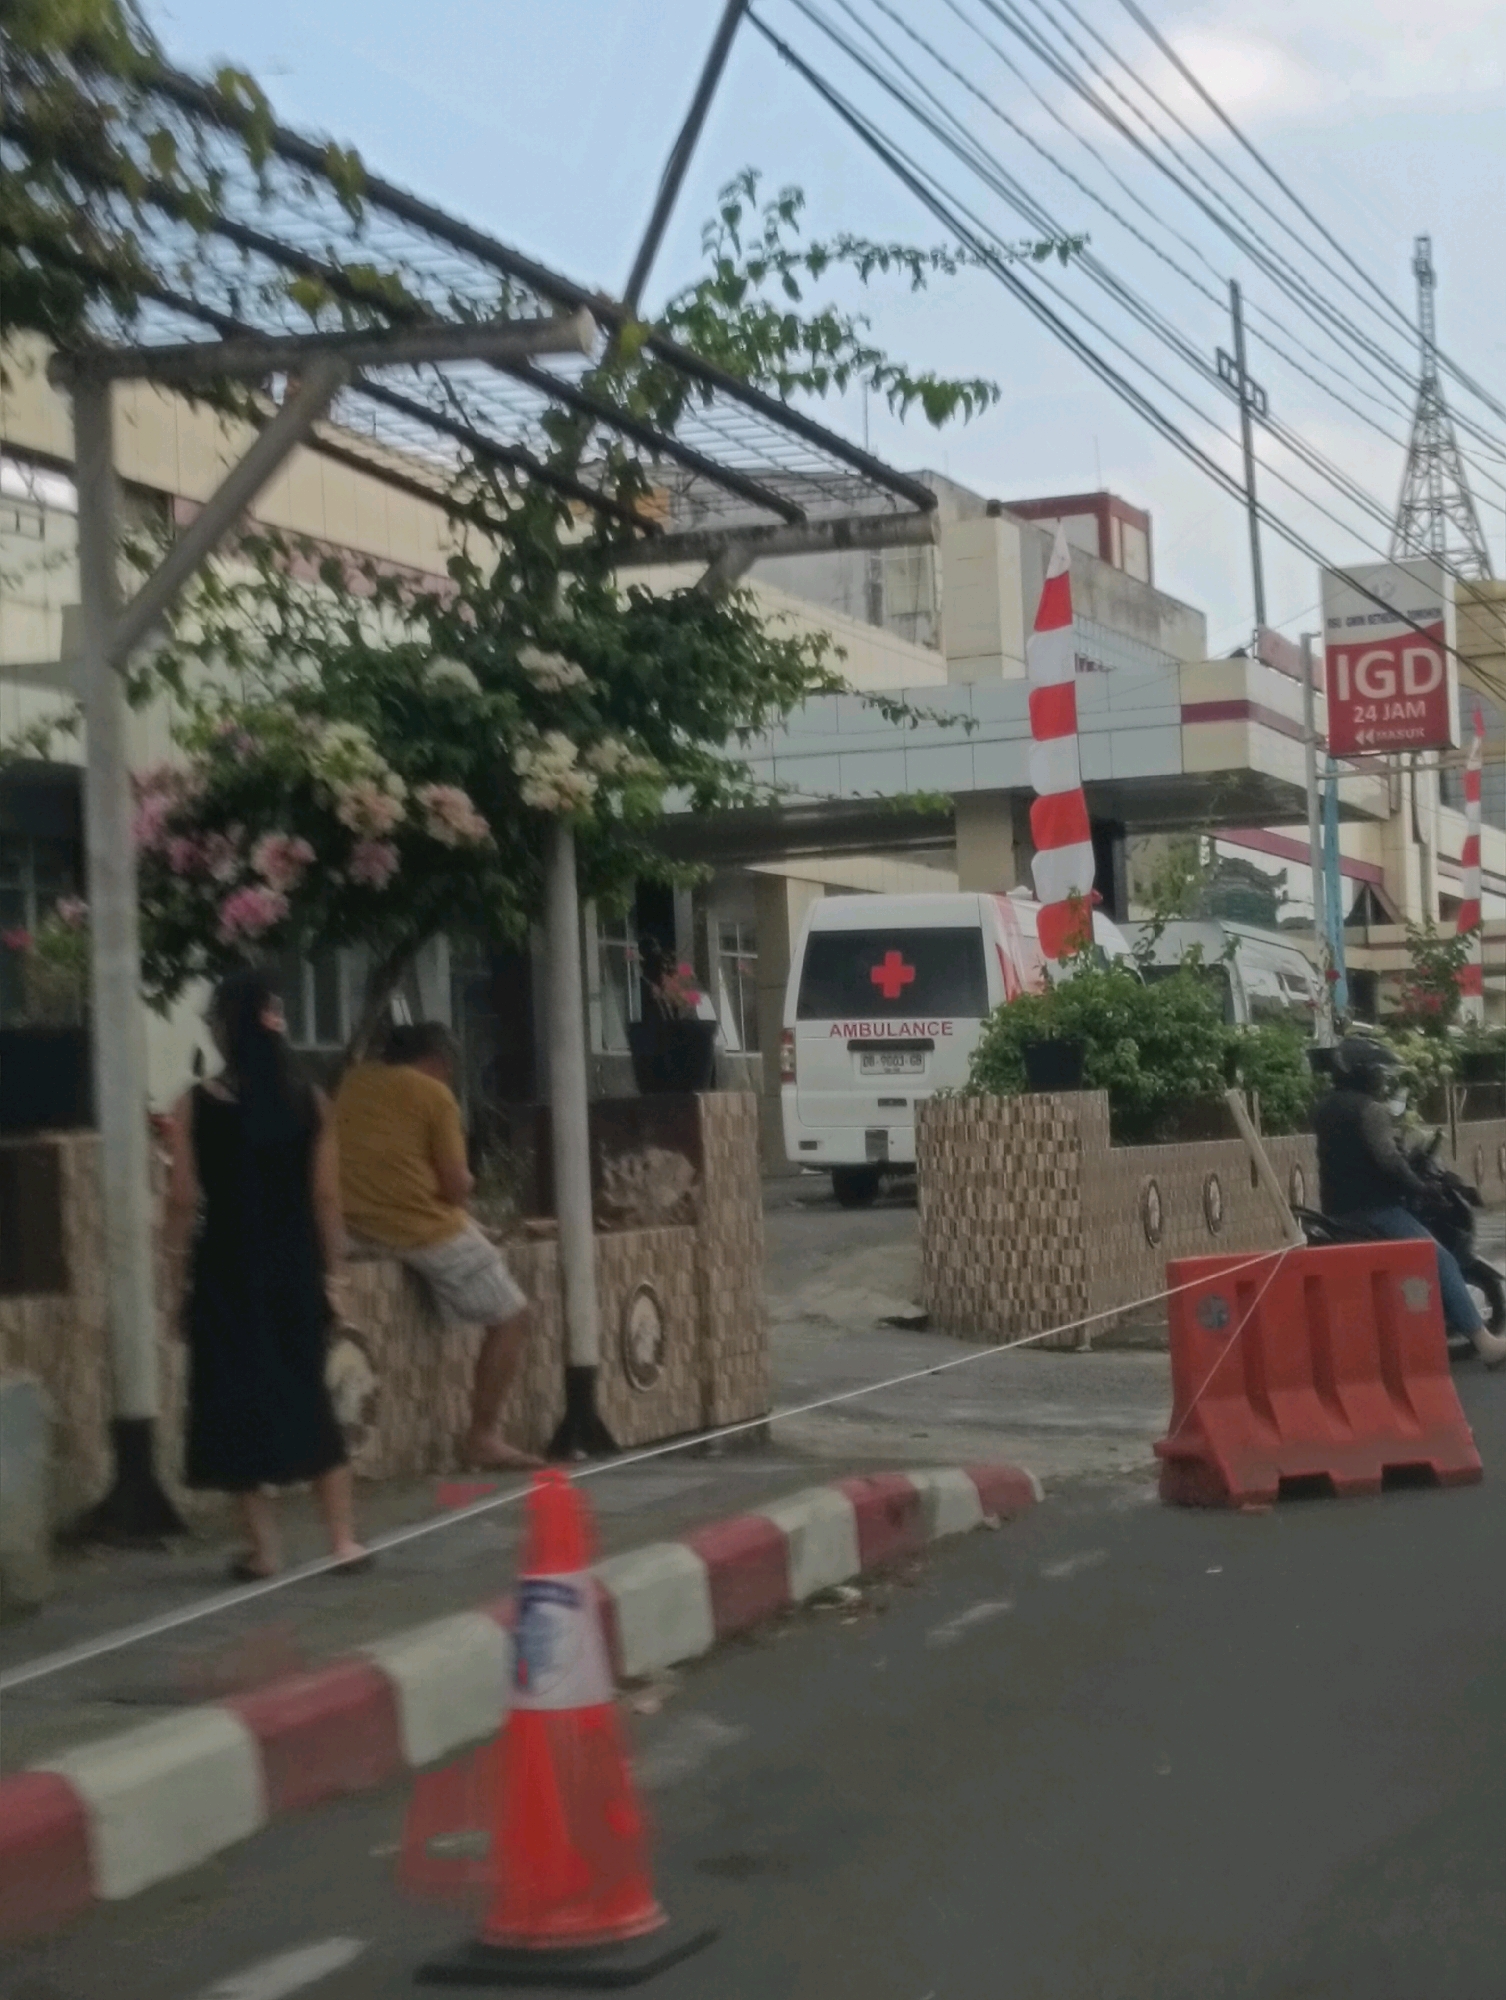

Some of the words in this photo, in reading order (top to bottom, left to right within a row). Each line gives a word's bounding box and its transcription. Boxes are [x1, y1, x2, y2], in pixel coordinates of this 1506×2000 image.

[1336, 647, 1443, 701] IGD
[1353, 704, 1378, 723] 24
[1382, 701, 1426, 721] JAM
[1376, 727, 1426, 741] MASUK
[829, 1021, 954, 1038] AMBULANCE
